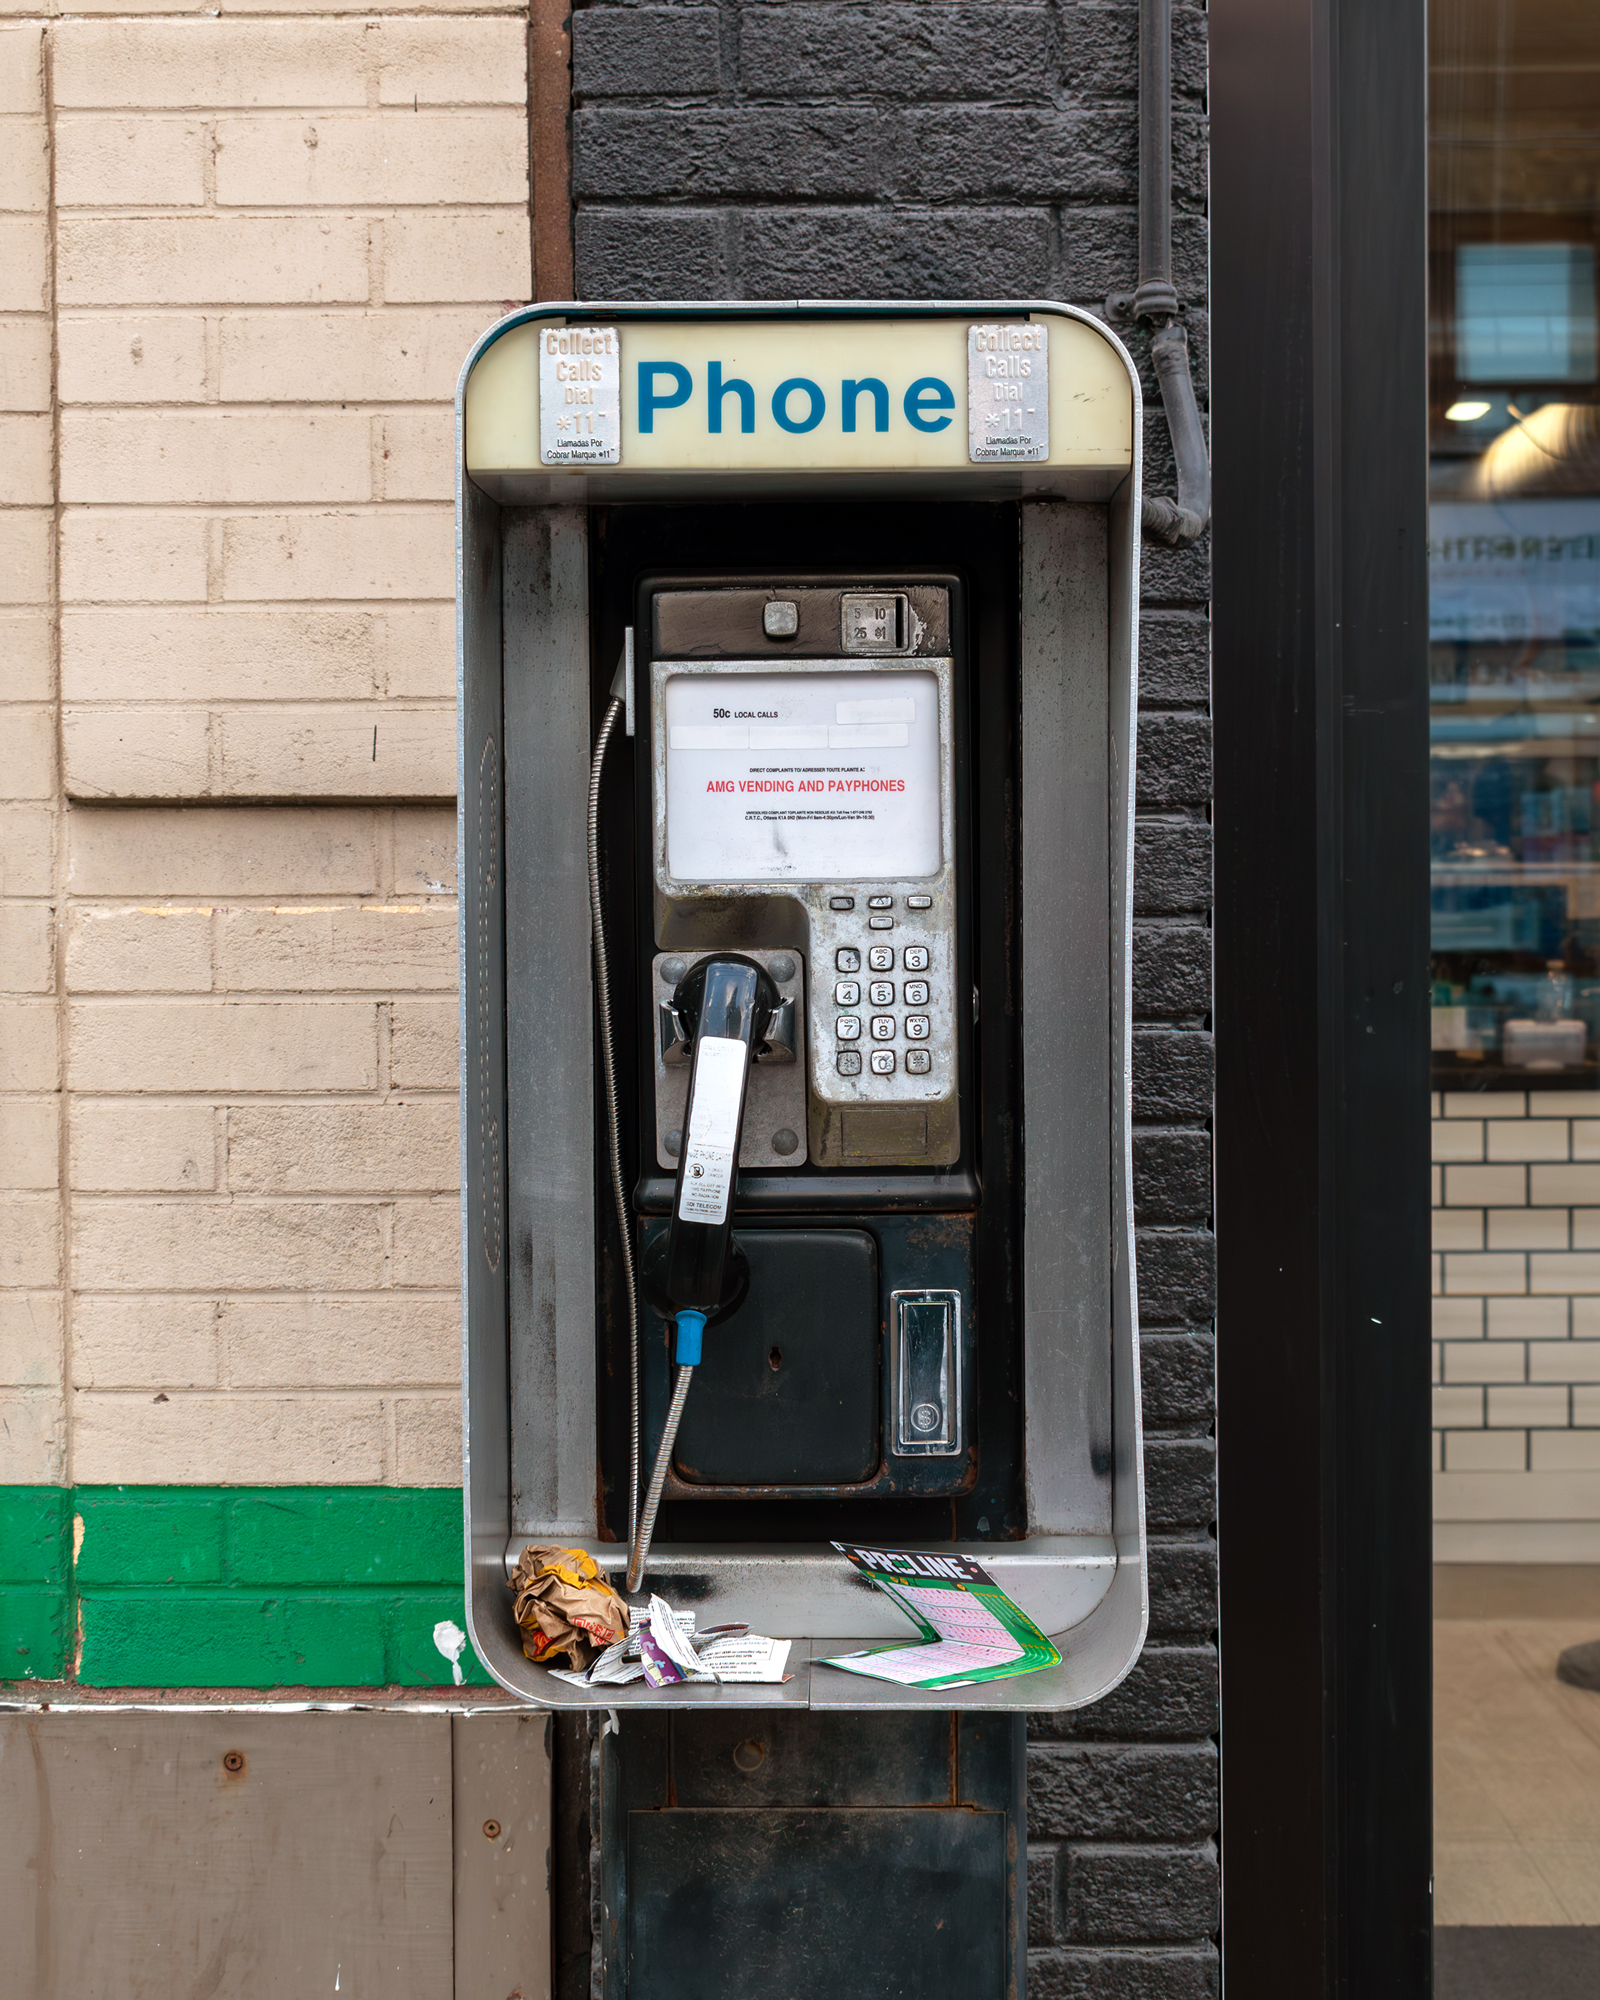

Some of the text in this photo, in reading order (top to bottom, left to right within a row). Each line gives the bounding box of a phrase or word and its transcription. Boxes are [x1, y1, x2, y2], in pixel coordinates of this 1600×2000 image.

[546, 332, 612, 355] Collect
[975, 328, 1041, 352] Collect
[556, 359, 603, 381] Calls
[985, 355, 1031, 378] Calls
[565, 386, 594, 404] Dial
[638, 361, 955, 434] Phone
[993, 383, 1023, 401] Dial
[557, 439, 603, 447] Llamadas Por
[986, 436, 1031, 444] Llamadas Por
[572, 450, 596, 460] Marque
[976, 448, 998, 456] Cobrar
[1000, 447, 1025, 457] Marque
[854, 608, 886, 620] 5 10
[854, 627, 867, 639] 25
[706, 780, 905, 793] AMG VENDING AND PAYPHONES
[877, 956, 886, 966] 2
[912, 956, 920, 967] 3
[843, 991, 922, 1002] 4 5 6
[844, 1024, 922, 1036] 7 8 9
[878, 1059, 887, 1070] 0
